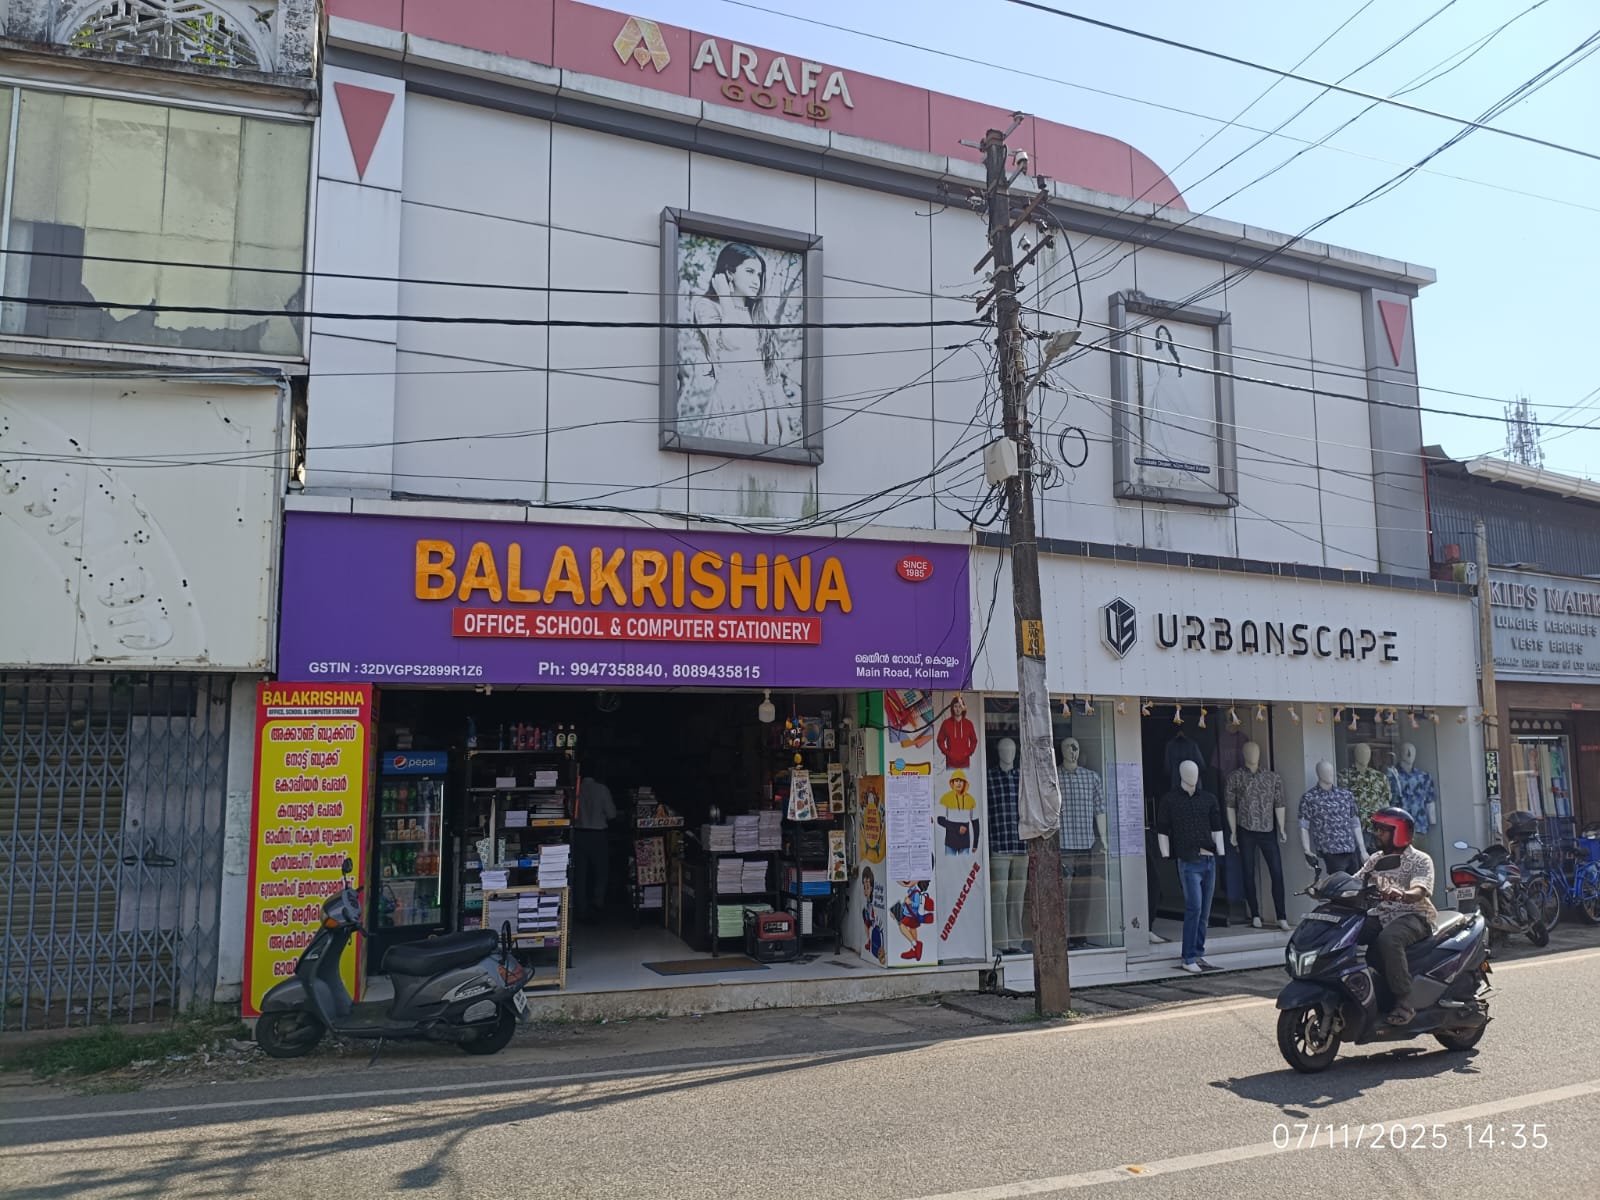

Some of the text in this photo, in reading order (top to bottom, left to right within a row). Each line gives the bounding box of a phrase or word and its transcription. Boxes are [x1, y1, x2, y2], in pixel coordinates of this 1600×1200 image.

[693, 39, 854, 109] ARAFA
[721, 82, 832, 121] GOLD
[903, 560, 927, 570] SINCE
[906, 569, 925, 578] 1985
[415, 539, 852, 613] BALAKRISHNA
[464, 613, 811, 641] OFFICE, SCHOOL & COMPUTER STATIONERY
[1496, 616, 1598, 637] LUNGIES KERCHIEFS
[1153, 612, 1399, 663] URBANSCAPE
[309, 661, 350, 674] GSTIN
[855, 652, 959, 667] മെയിൻ റോഡ്, കൊല്ലം
[538, 662, 760, 679] Ph: 9947358840, 8089435815
[857, 667, 949, 678] Main Road, Kollam
[262, 691, 364, 705] BALAKRISHNA
[408, 758, 436, 768] pepsi
[940, 862, 981, 942] URBANSCAPE
